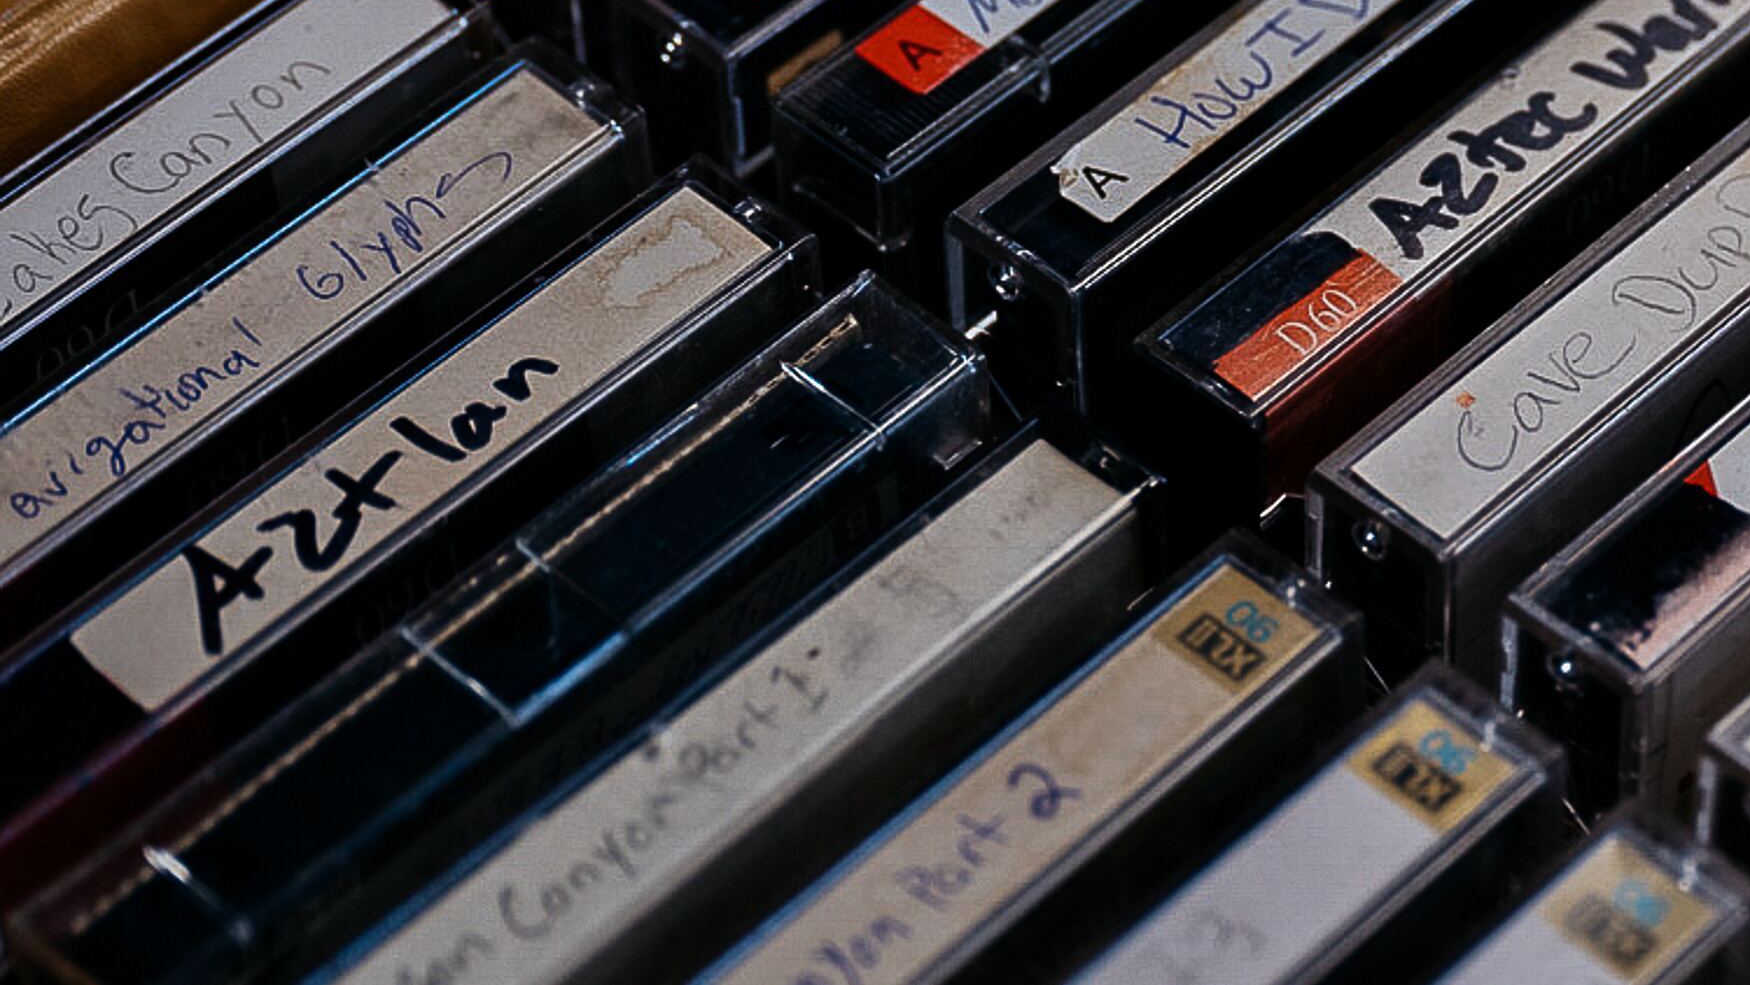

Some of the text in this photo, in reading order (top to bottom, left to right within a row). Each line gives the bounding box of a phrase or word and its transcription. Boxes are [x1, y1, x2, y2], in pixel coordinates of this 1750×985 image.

[107, 53, 332, 196] Canyon
[896, 38, 942, 72] A
[1134, 51, 1273, 150] How
[1081, 165, 1130, 200] A
[1369, 93, 1599, 260] Aztec
[1274, 285, 1358, 357] D60
[10, 315, 262, 519] avigational
[1456, 330, 1638, 473] Cave
[178, 357, 560, 656] Aztlan
[1226, 599, 1281, 644] 90
[896, 812, 1008, 911] Part
[1007, 762, 1084, 820] 2
